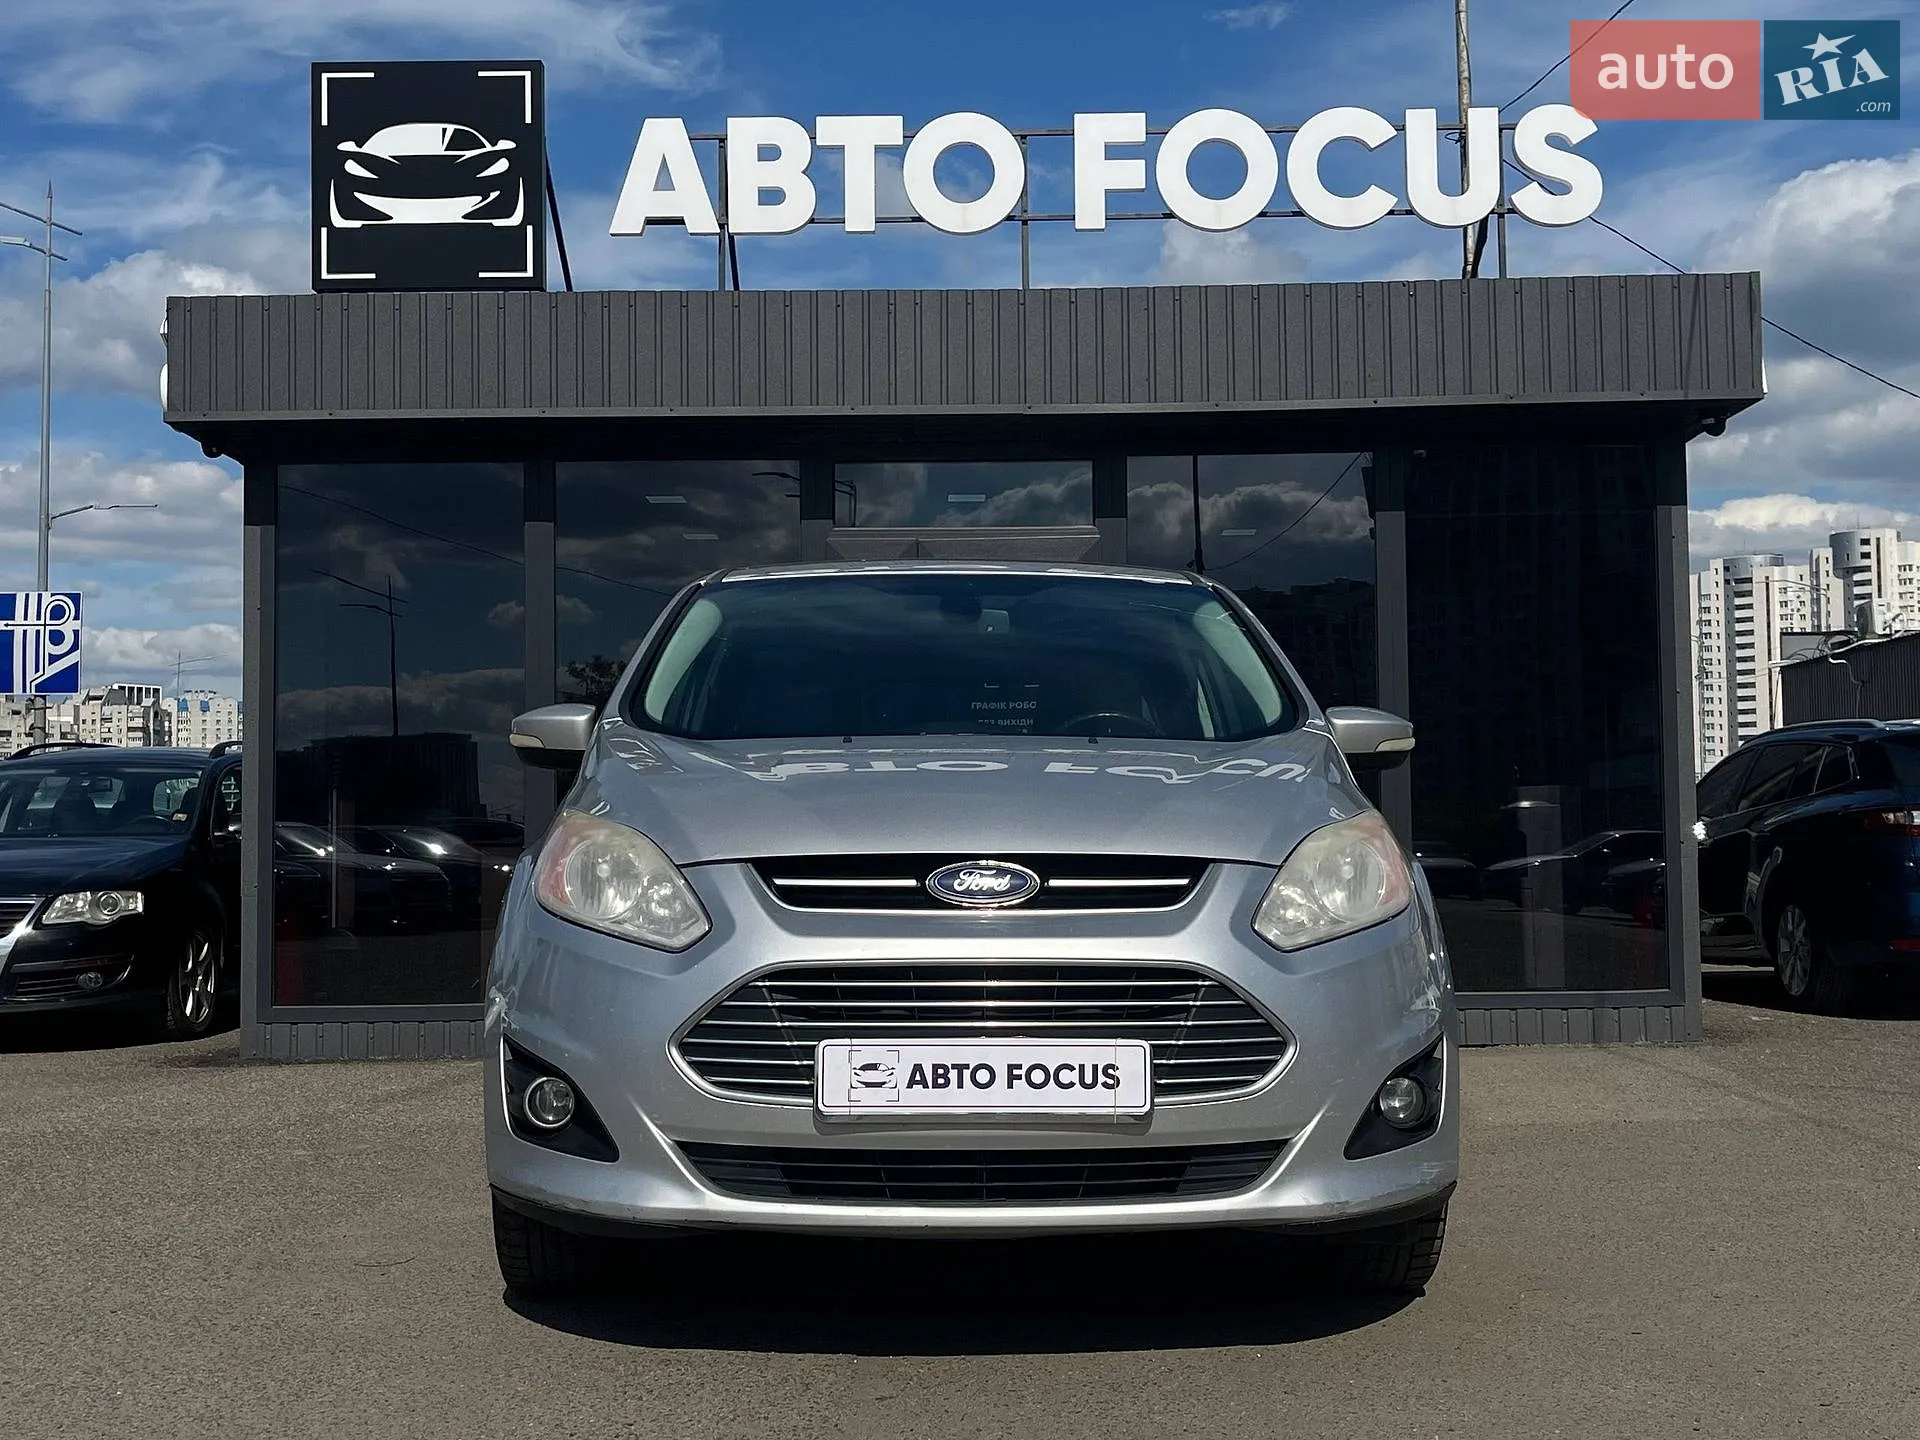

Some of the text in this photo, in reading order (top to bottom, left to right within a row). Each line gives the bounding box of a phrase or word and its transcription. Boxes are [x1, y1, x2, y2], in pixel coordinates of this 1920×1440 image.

[608, 104, 1603, 236] АВТО FOCUS
[971, 702, 1006, 710] ГРАФІК
[953, 869, 1011, 892] Ford
[906, 1062, 1121, 1090] АВТО FOCUS
